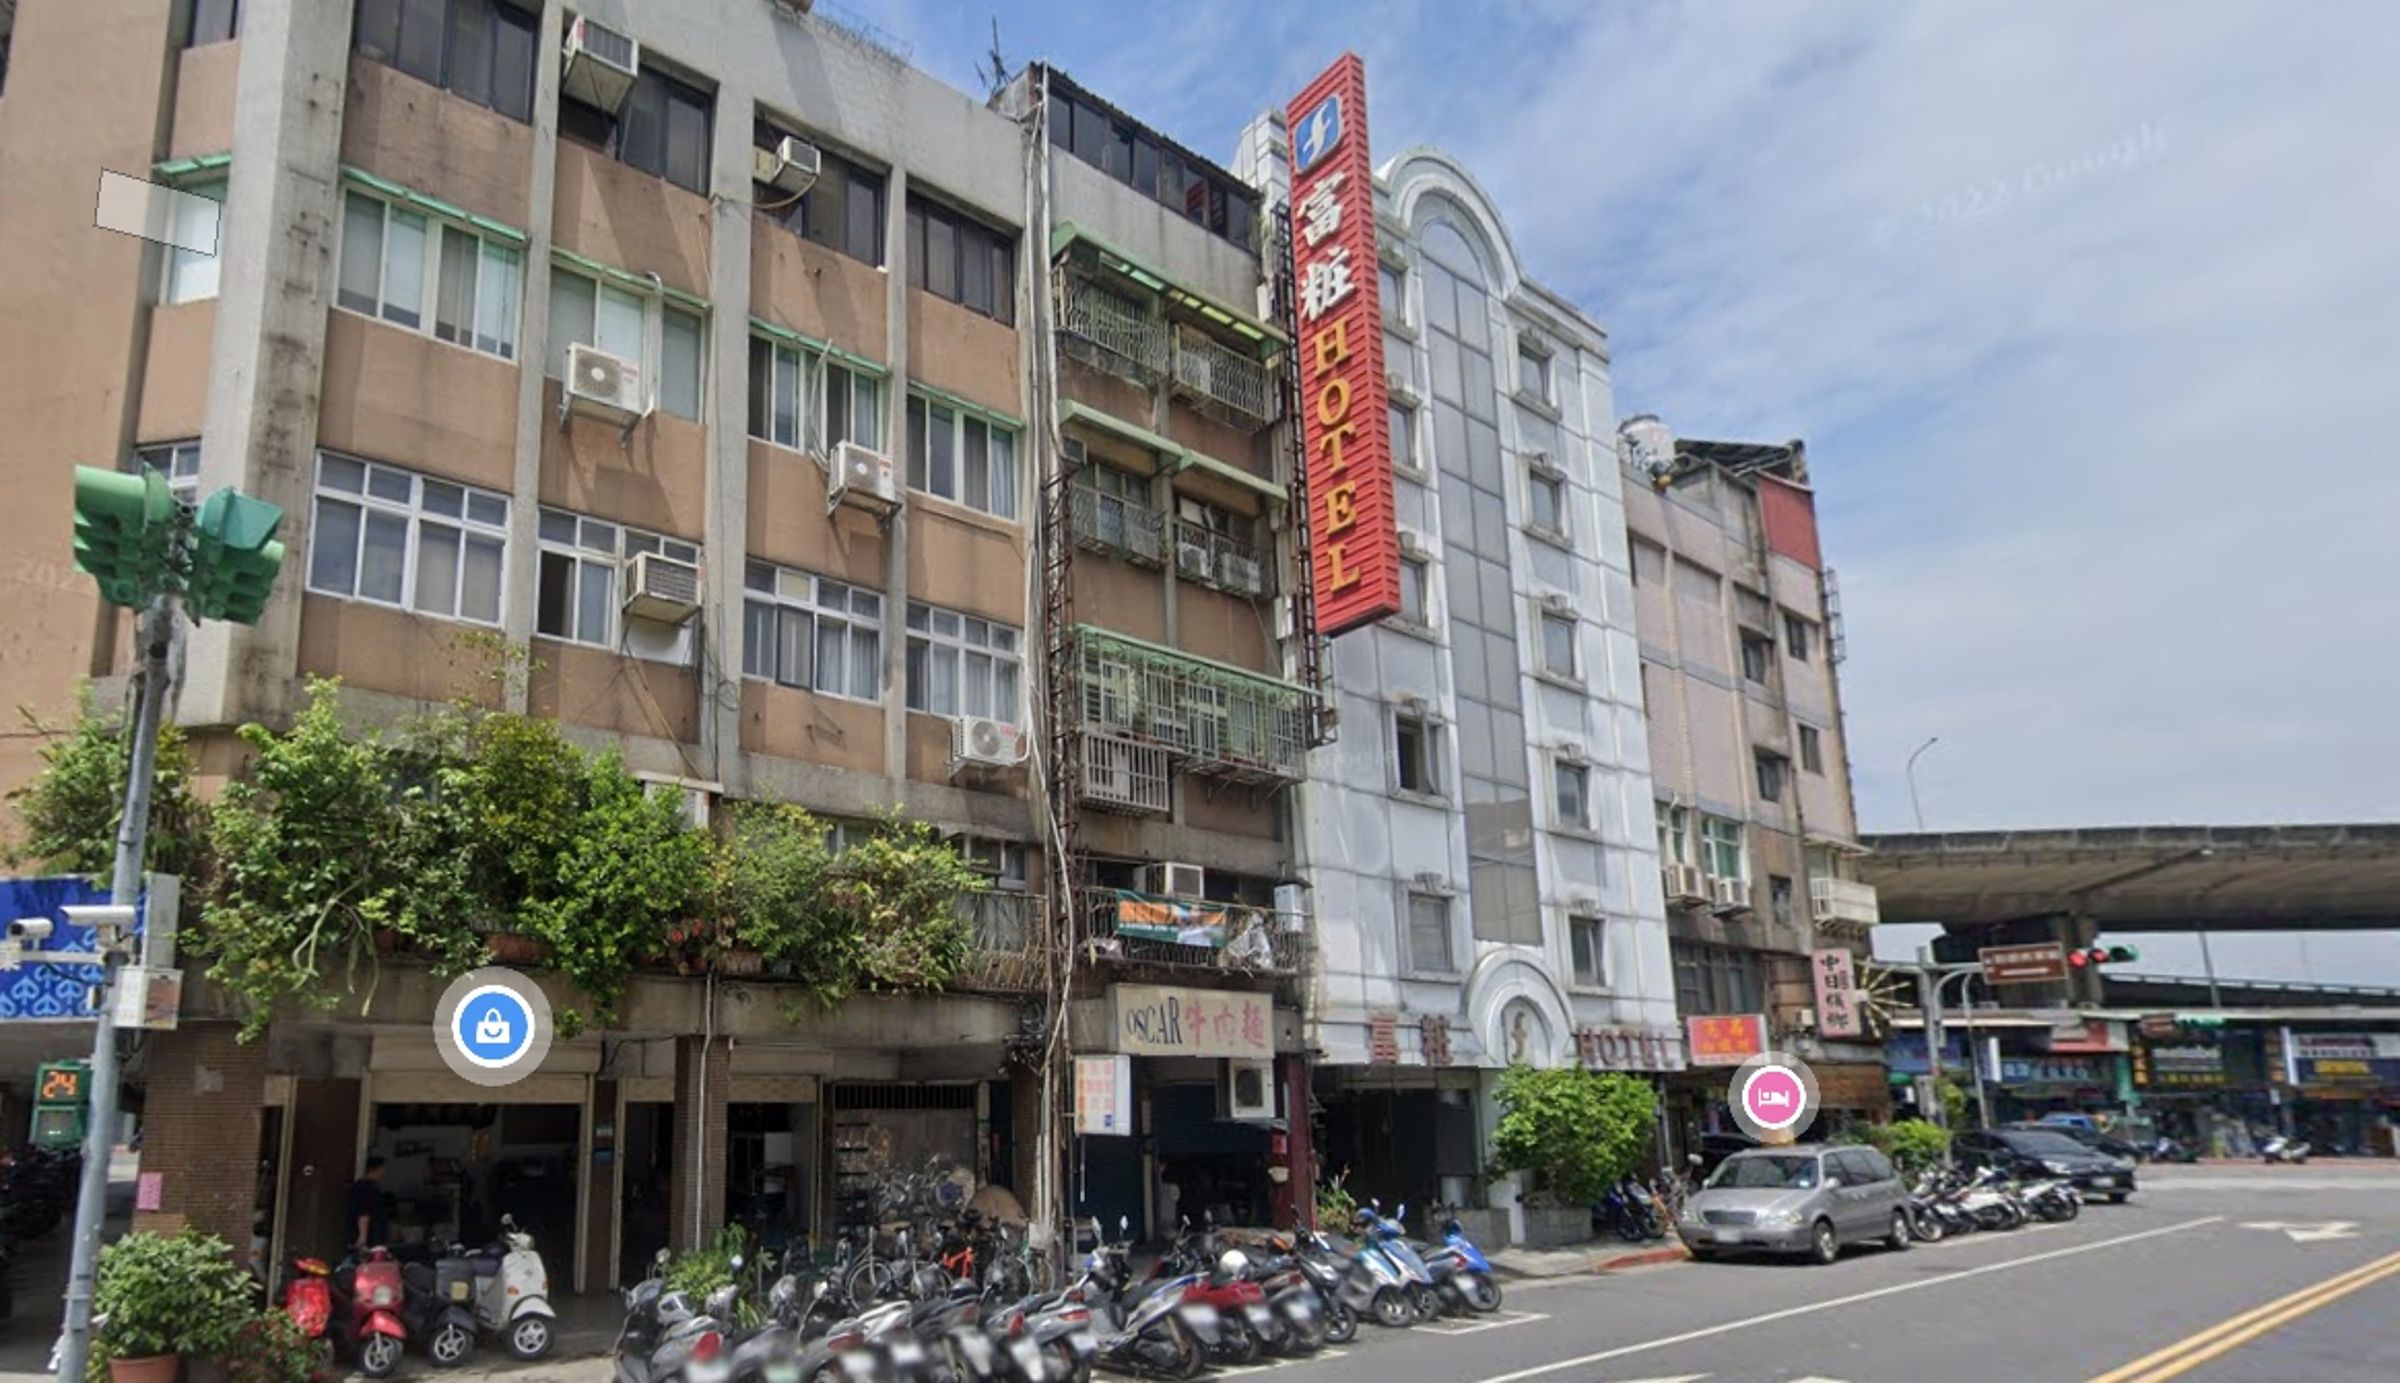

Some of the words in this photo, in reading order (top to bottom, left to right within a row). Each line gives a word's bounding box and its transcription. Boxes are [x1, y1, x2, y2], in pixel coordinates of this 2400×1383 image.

[1296, 172, 1356, 322] 富粧
[1312, 316, 1361, 593] HOTEL
[1126, 996, 1183, 1044] OSCAR
[1578, 1025, 1674, 1068] HOTEL
[42, 1071, 77, 1099] 24
